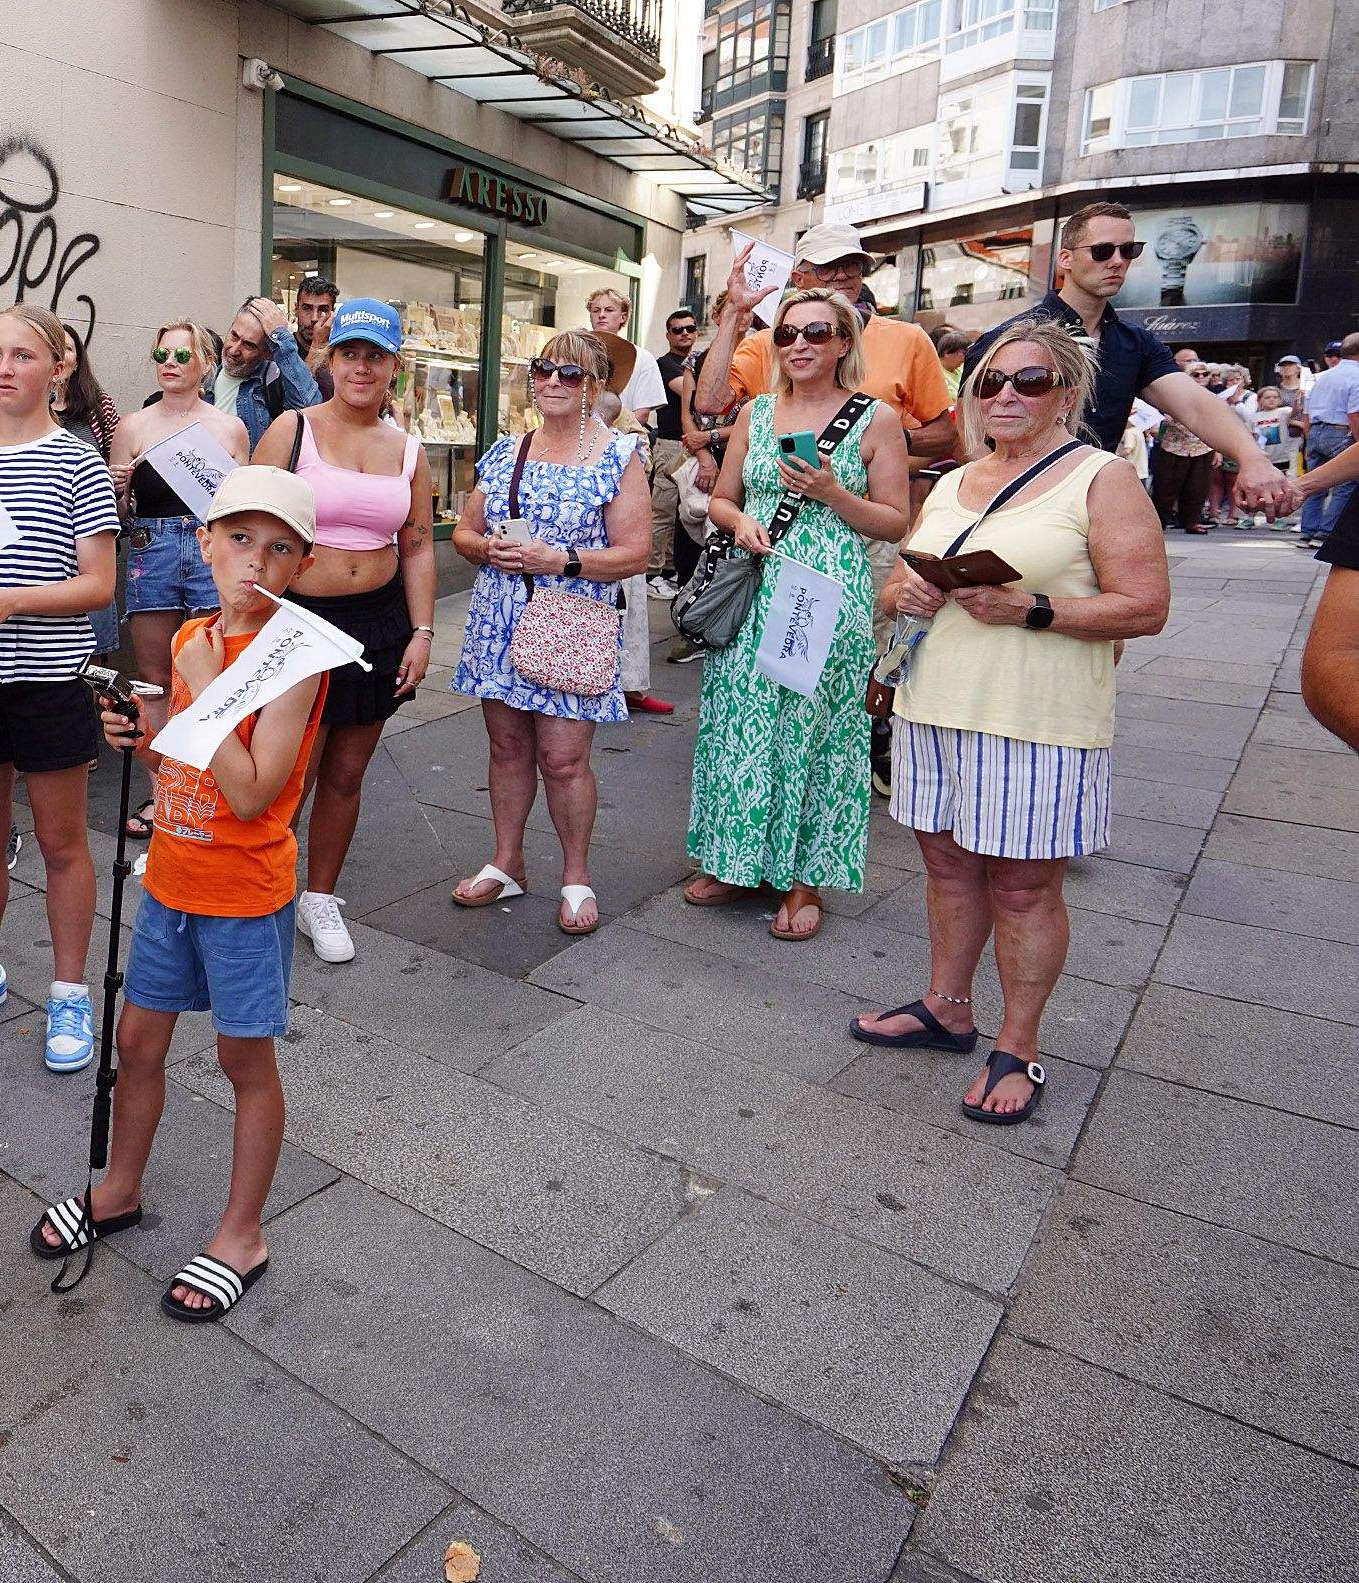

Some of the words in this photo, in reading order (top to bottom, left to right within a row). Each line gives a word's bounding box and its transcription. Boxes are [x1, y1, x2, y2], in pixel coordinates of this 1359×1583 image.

[454, 165, 548, 226] ARESSO
[340, 310, 391, 329] Multisport
[175, 451, 216, 498] PONTEVEDRA
[778, 587, 808, 660] PONTEVEDRA
